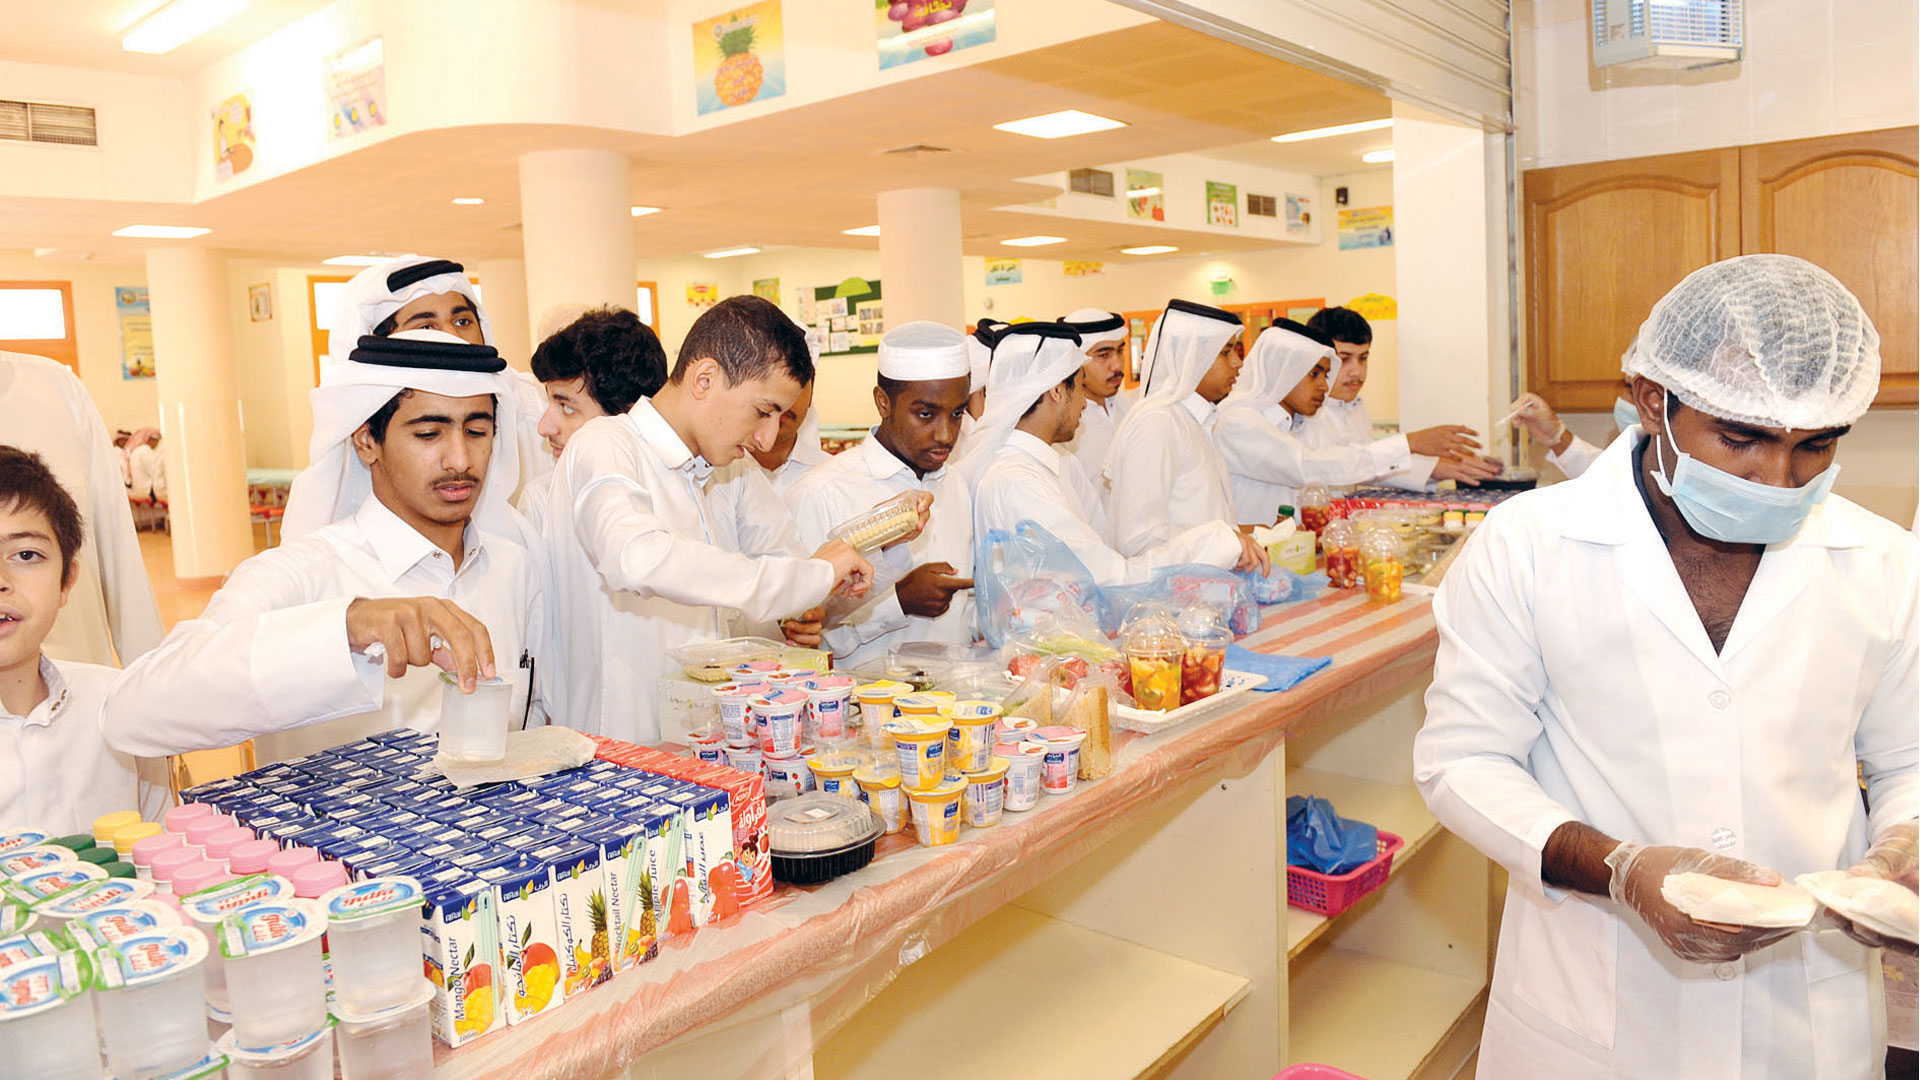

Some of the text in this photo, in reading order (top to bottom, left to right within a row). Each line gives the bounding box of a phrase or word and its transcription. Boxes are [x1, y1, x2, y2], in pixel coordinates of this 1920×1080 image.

[610, 871, 619, 907] Nectar
[650, 849, 662, 923] Apple Juice
[506, 914, 526, 997] نكتار المانجو
[559, 893, 577, 972] نكتار الكوكتيل
[448, 937, 467, 1021] Mango Nectar
